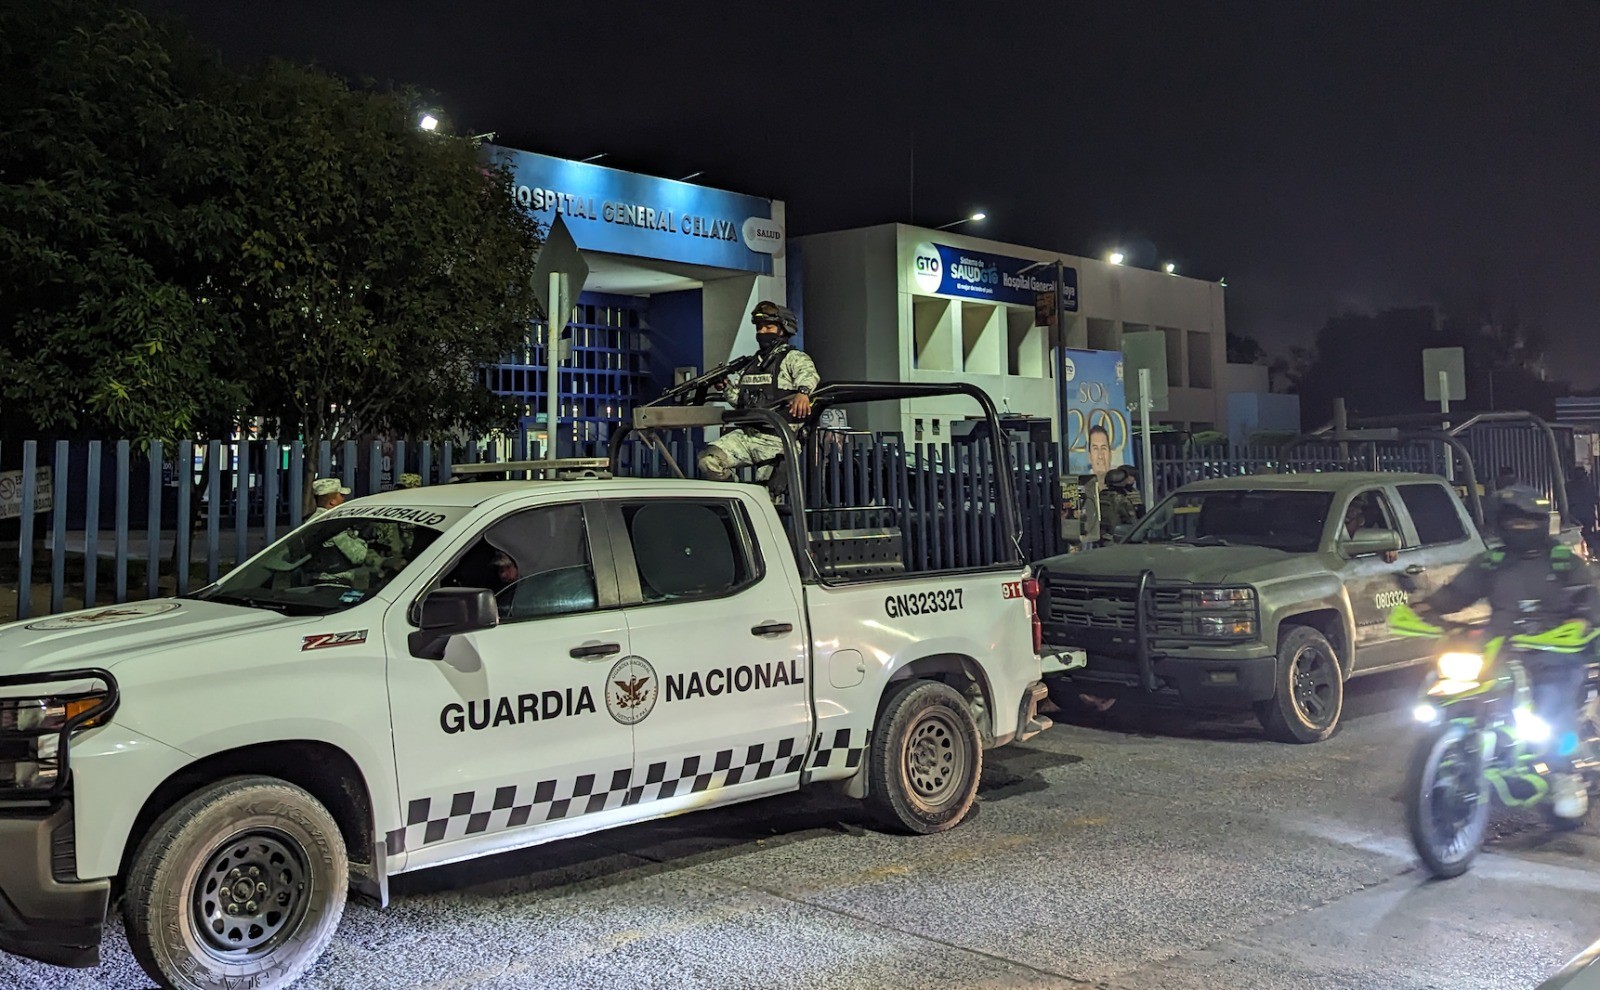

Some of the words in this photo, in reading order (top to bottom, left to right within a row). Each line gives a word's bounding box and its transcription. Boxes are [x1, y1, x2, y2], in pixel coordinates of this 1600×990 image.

[602, 201, 677, 233] GENERAL
[681, 215, 738, 242] CELAYA
[756, 228, 781, 240] SALUD
[916, 256, 939, 272] GTO
[1002, 272, 1030, 291] Hospital
[1030, 277, 1055, 292] General
[1079, 381, 1110, 405] SOY
[1002, 583, 1022, 598] 911
[1375, 590, 1408, 609] 0803324
[884, 588, 964, 619] GN323327
[302, 629, 368, 652] Z71
[440, 686, 597, 734] GUARDIA
[666, 659, 805, 702] NACIONAL
